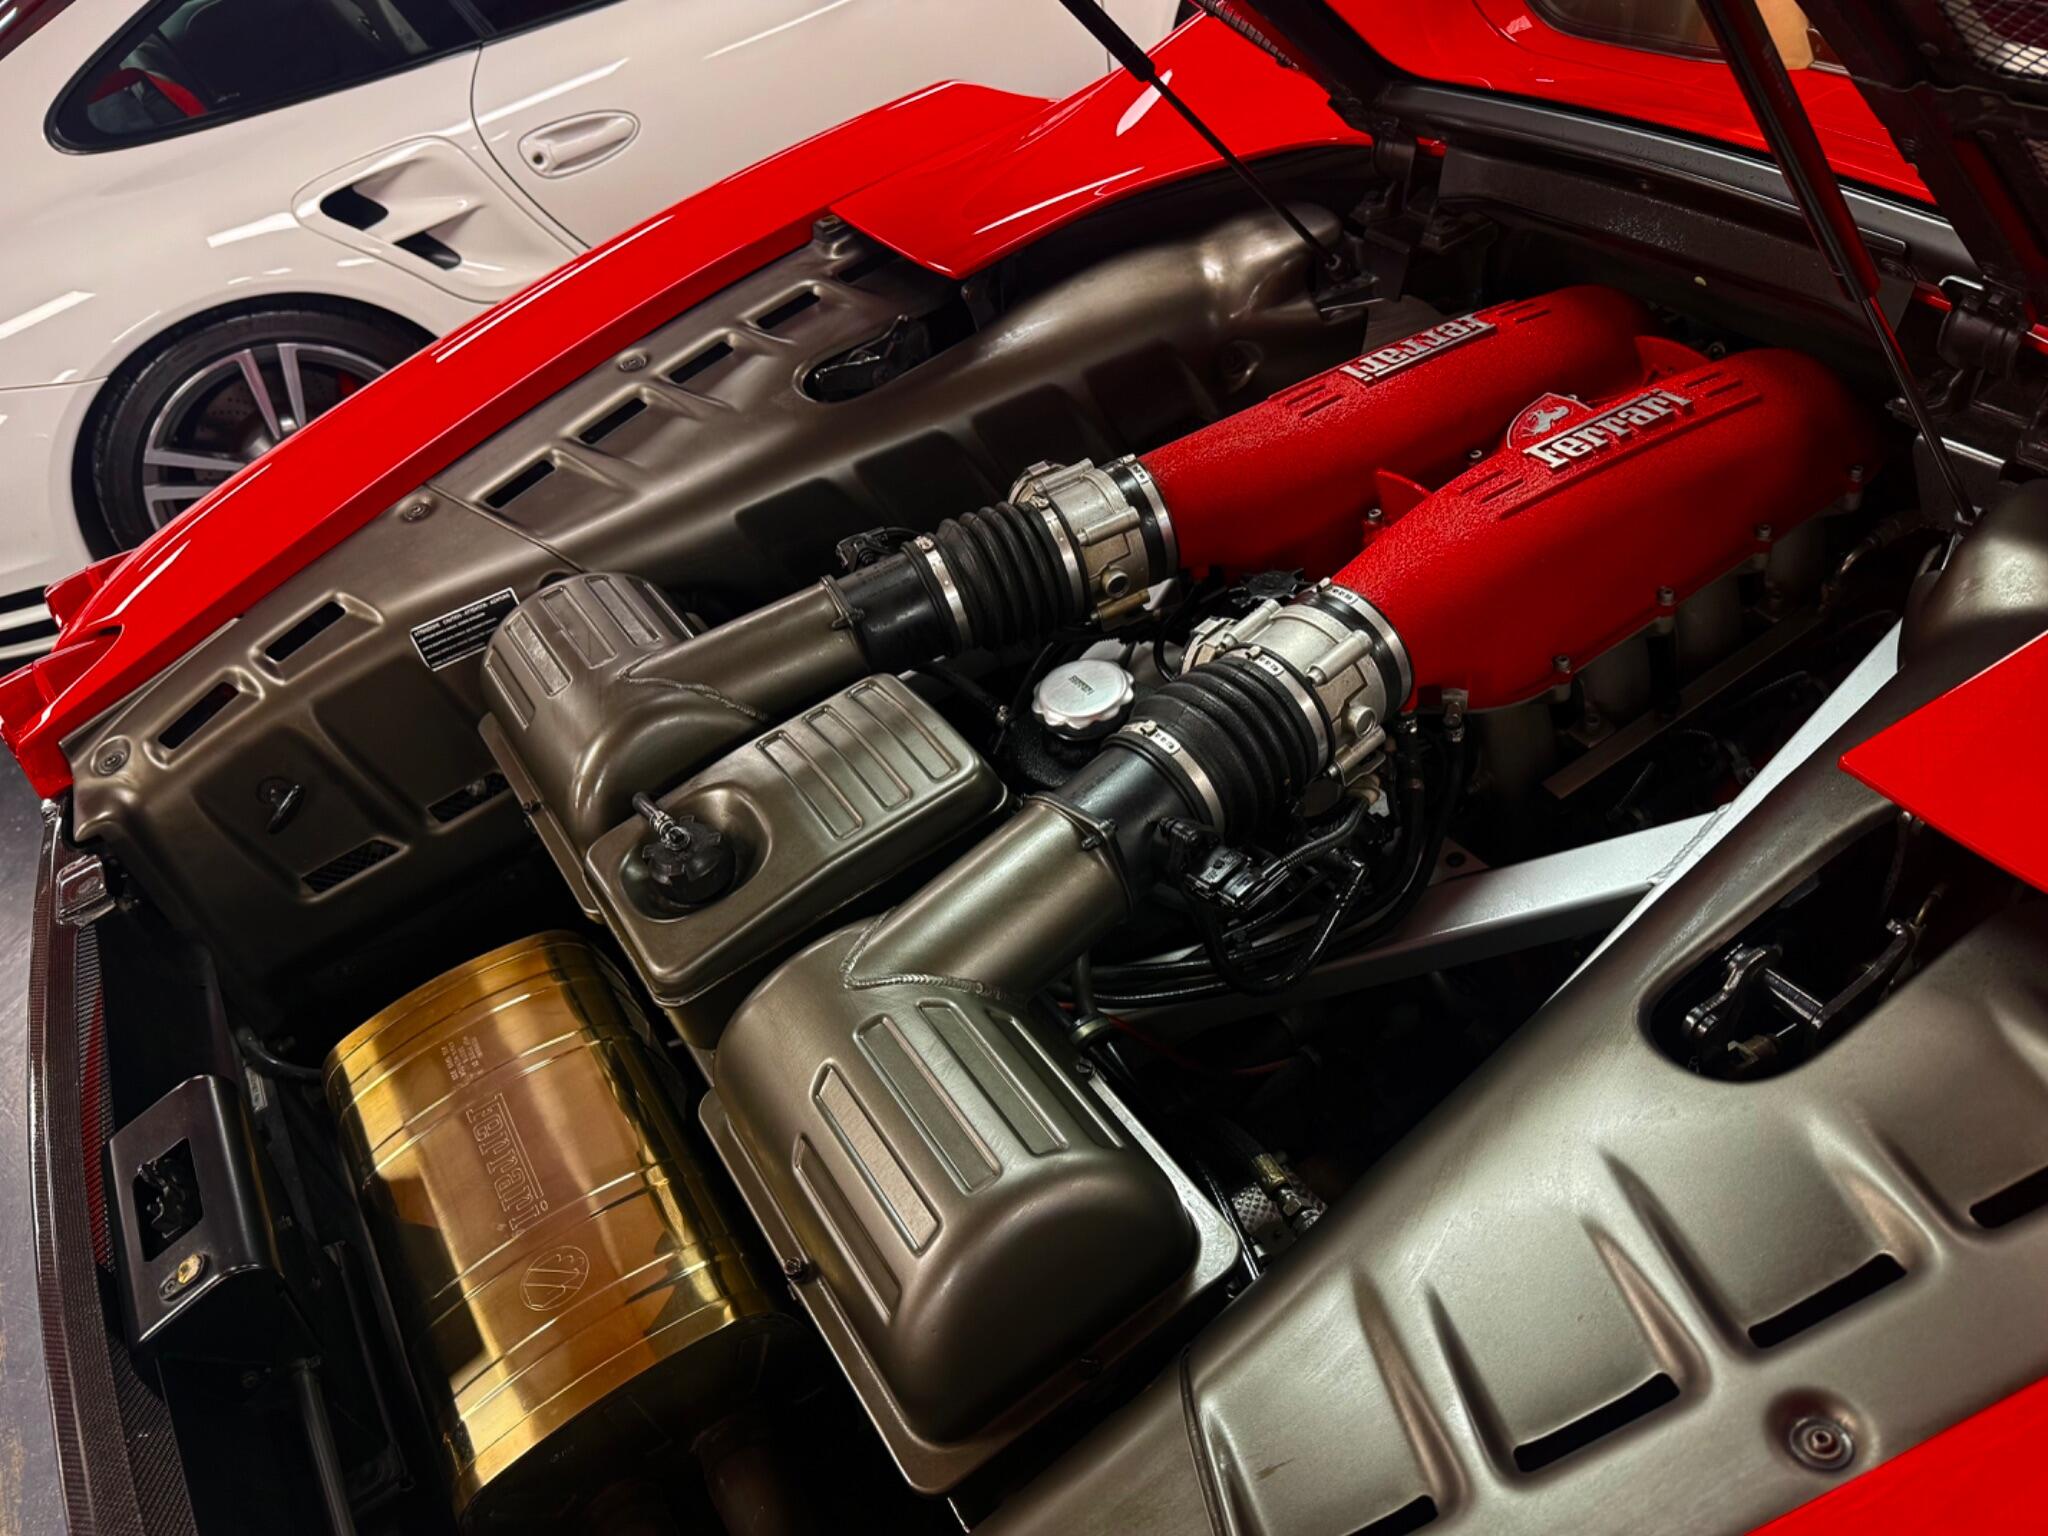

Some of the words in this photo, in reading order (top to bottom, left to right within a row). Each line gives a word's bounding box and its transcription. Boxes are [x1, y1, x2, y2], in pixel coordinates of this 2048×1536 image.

[1339, 313, 1497, 382] Ferrari
[1522, 388, 1693, 469] Ferrari
[465, 1092, 549, 1237] Ferrari
